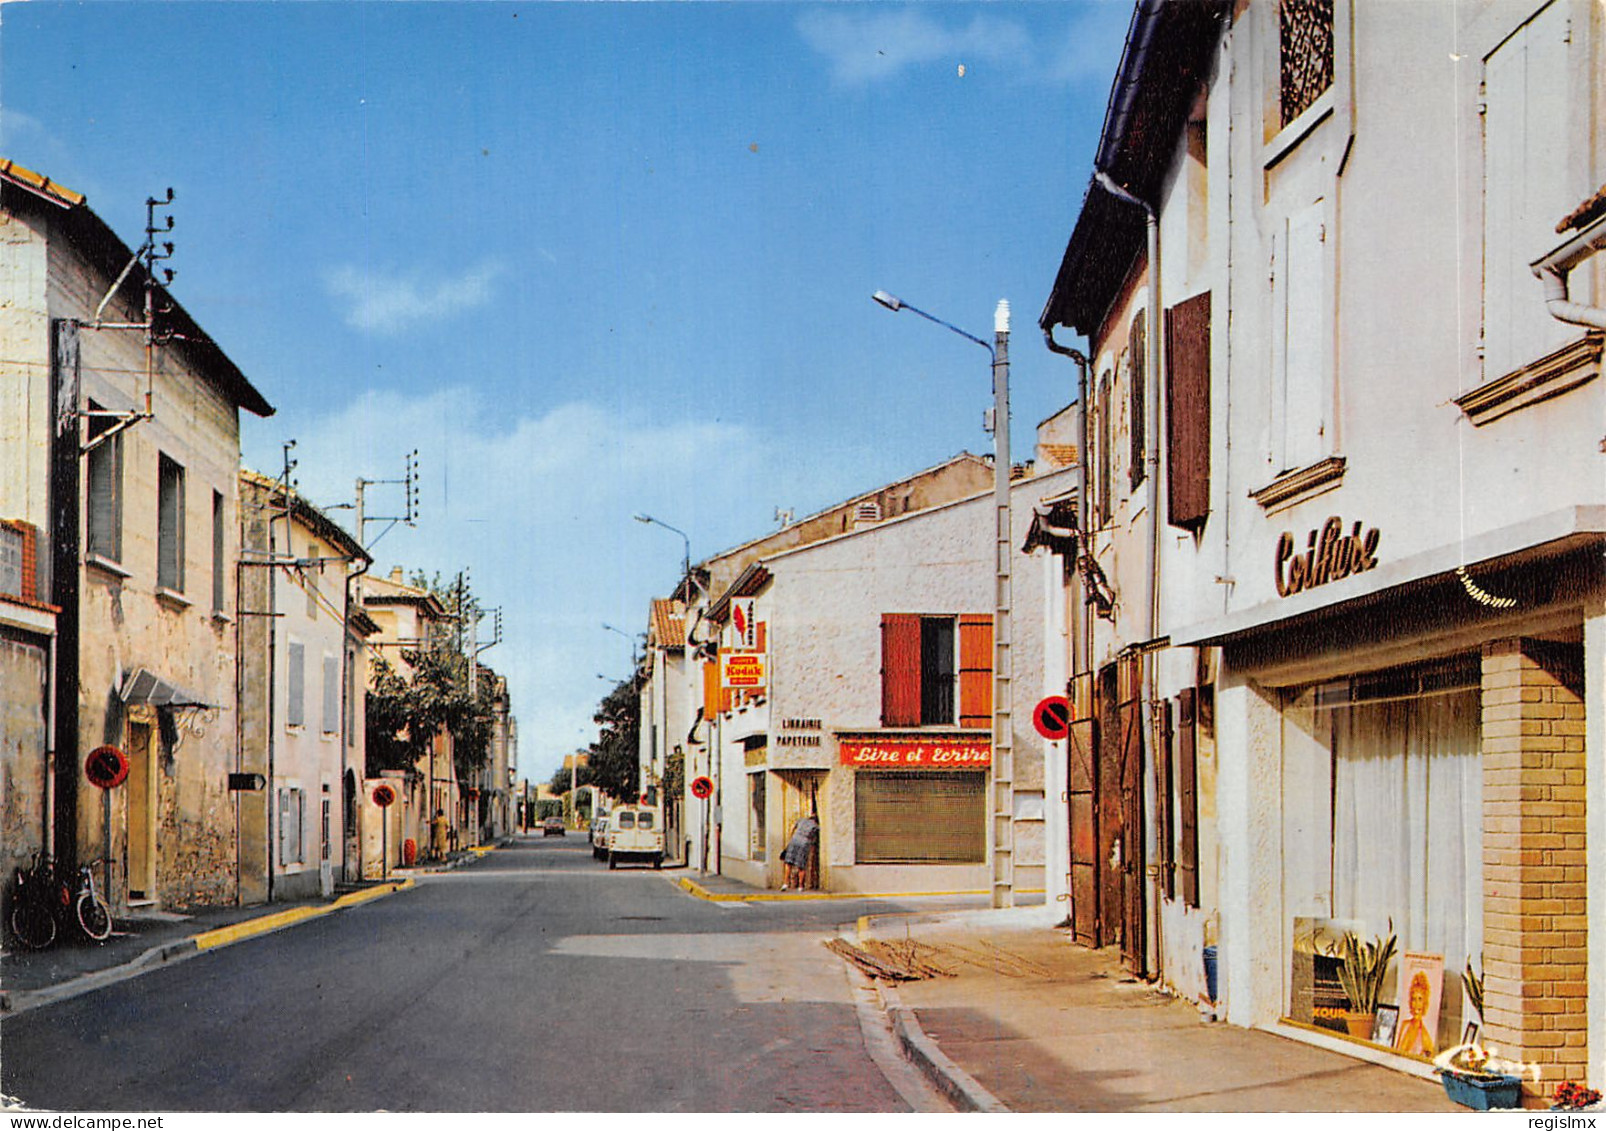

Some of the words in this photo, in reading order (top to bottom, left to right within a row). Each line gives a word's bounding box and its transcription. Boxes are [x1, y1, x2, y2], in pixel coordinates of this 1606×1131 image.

[727, 666, 761, 676] Kodak
[782, 718, 822, 730] LIBRAIRIE
[776, 735, 821, 747] PAPETERIE
[854, 747, 900, 762] Lire
[906, 747, 923, 762] et
